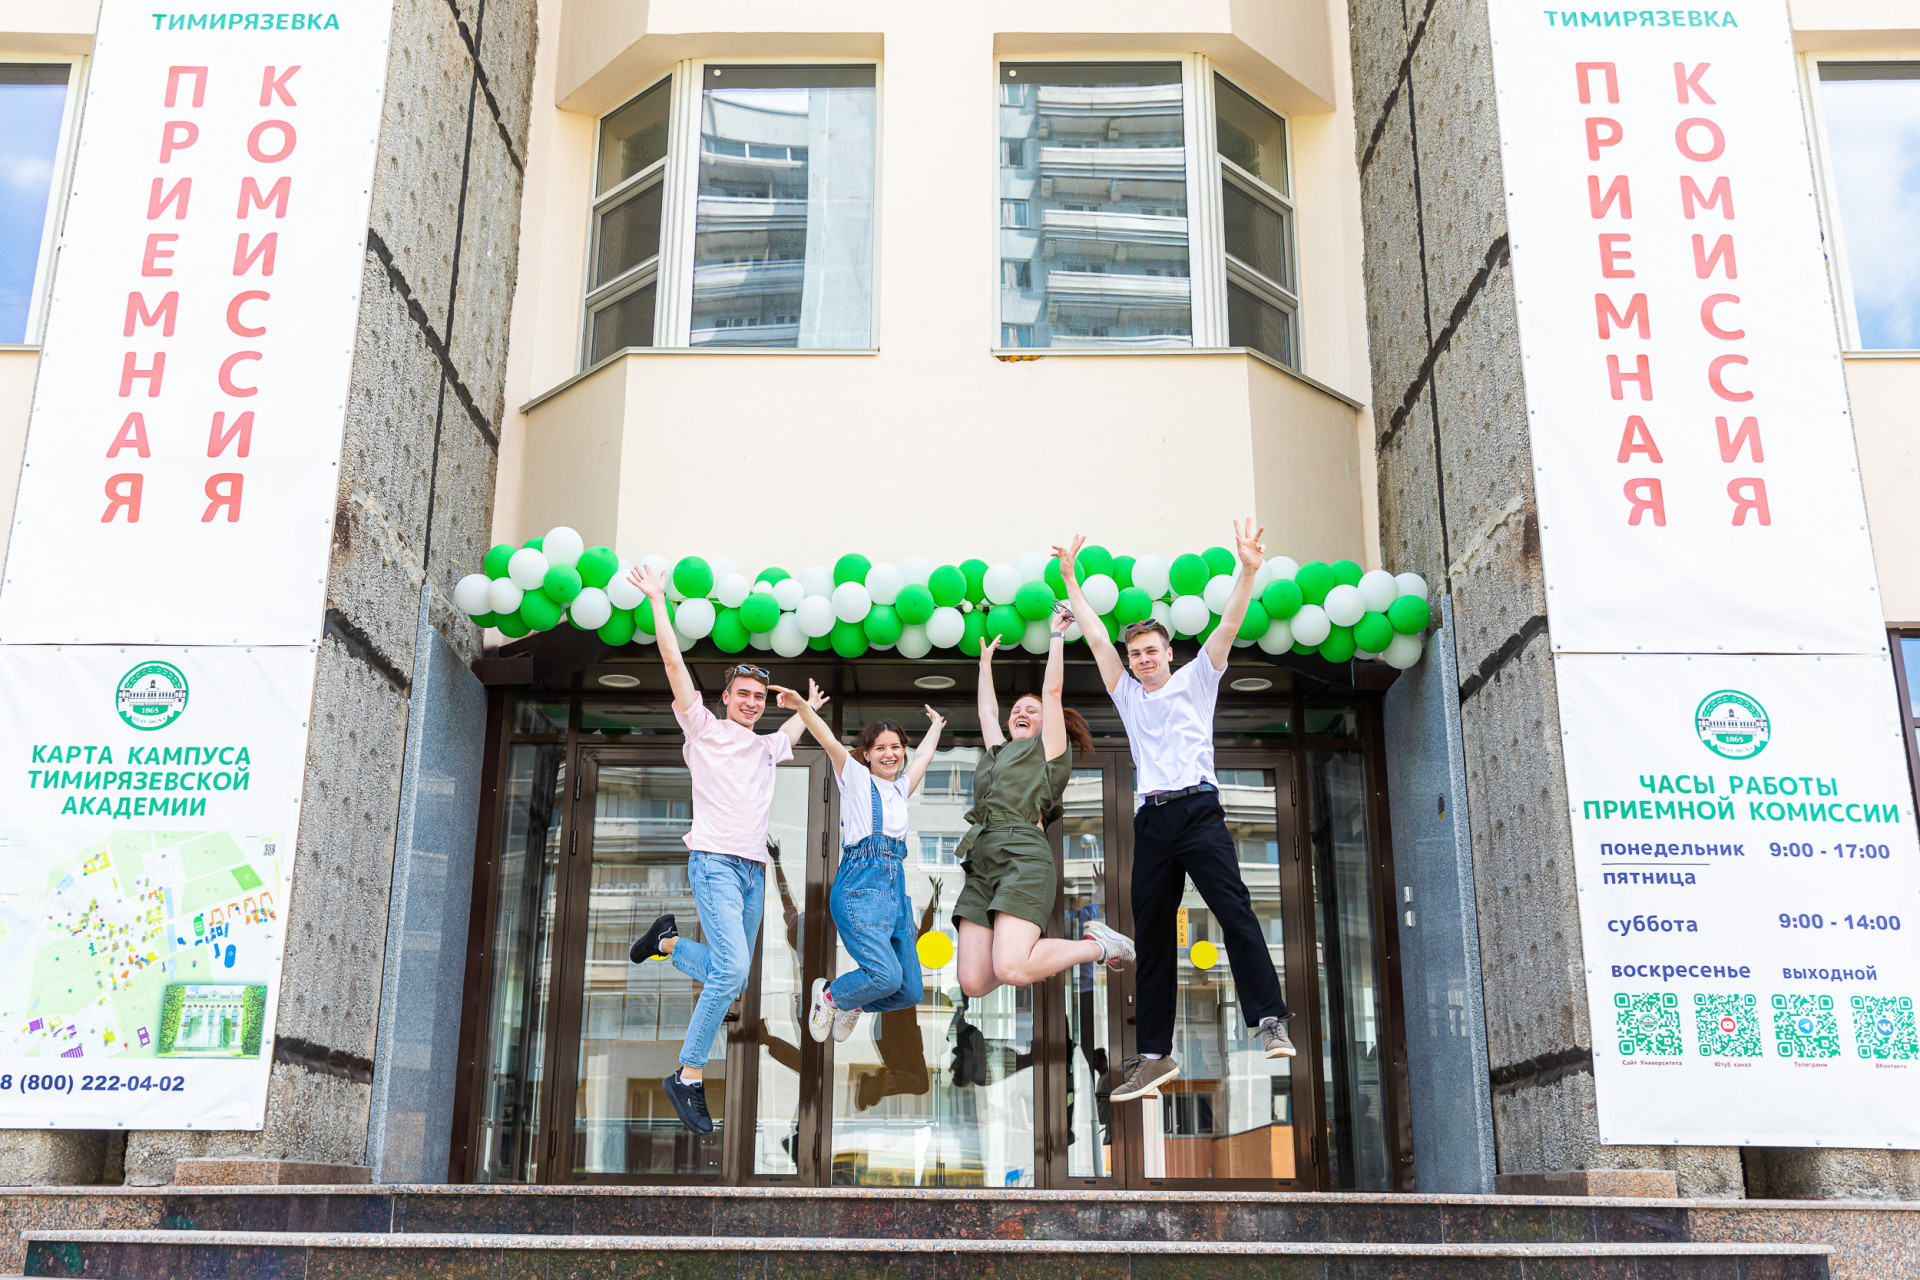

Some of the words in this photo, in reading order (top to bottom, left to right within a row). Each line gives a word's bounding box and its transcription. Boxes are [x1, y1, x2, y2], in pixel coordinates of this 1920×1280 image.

[151, 12, 340, 31] ТИМИРЯЗЕВКА
[1543, 9, 1739, 29] ТИМИРЯЗЕВКА
[100, 65, 209, 524] ПРИЕМНАЯ
[200, 65, 302, 523] КОМИССИЯ
[1575, 61, 1667, 527] ПРИЕМНАЯ
[1673, 61, 1772, 527] КОМИССИЯ
[1725, 736, 1744, 744] 1865
[31, 744, 114, 765] КАРТА
[127, 746, 251, 767] КАМПУСА
[27, 766, 250, 792] ТИМИРЯЗЕВСКОЙ
[1639, 774, 1716, 795] ЧАСЫ
[1730, 775, 1839, 797] РАБОТЫ
[60, 795, 207, 820] АКАДЕМИИ
[1582, 796, 1736, 821] ПРИЕМНОЙ
[1748, 801, 1900, 824] КОМИССИИ
[1600, 842, 1746, 858] понедельник
[1768, 841, 1814, 858] 9:00
[1833, 843, 1891, 860] 17:00
[1602, 871, 1697, 888] пятница
[1607, 914, 1699, 936] суббота
[1778, 912, 1824, 930] 9:00
[1843, 914, 1901, 931] 14:00
[1610, 963, 1751, 983] воскресенье
[1782, 965, 1878, 983] выходной
[1793, 1061, 1828, 1069] Телеграмм
[0, 1074, 13, 1091] 8
[19, 1074, 74, 1096] (800)
[80, 1074, 185, 1092] 222-04-02
